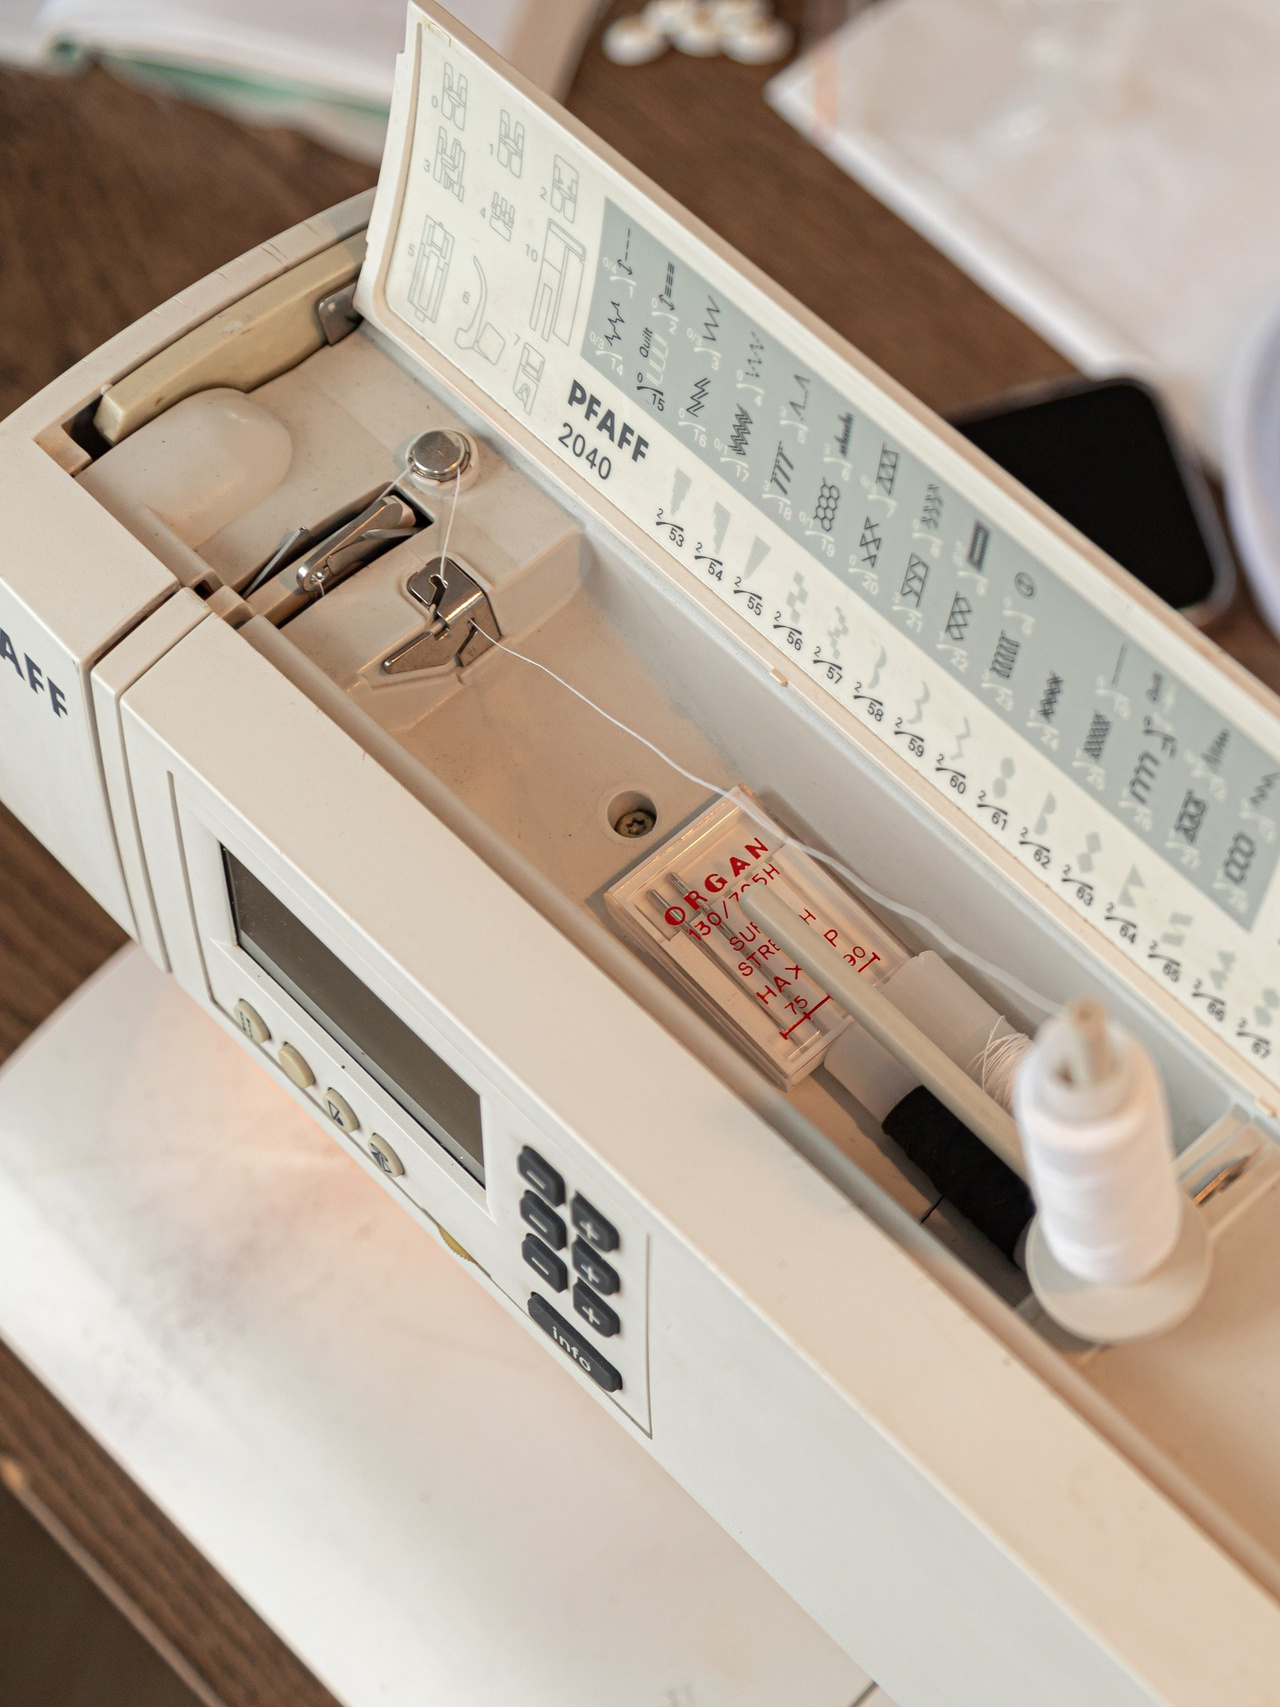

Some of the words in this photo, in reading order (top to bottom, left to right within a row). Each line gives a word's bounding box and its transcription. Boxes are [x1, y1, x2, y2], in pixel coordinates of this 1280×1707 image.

[431, 95, 438, 109] 0
[423, 159, 431, 173] 3
[540, 187, 548, 201] 2
[480, 207, 487, 219] 4
[408, 243, 416, 257] 5
[525, 243, 538, 263] 10
[462, 291, 471, 305] 6
[513, 333, 520, 346] 7
[639, 327, 653, 358] Quilt
[669, 321, 677, 335] 2
[590, 331, 605, 350] 0/3
[610, 357, 624, 377] 14
[711, 356, 720, 371] 3
[637, 372, 643, 383] 0
[652, 393, 665, 412] 15
[755, 394, 763, 408] 4
[567, 379, 650, 464] PFAFF
[679, 408, 685, 419] 0
[693, 428, 707, 448] 16
[558, 422, 612, 480] 2040
[735, 464, 750, 482] 17
[656, 508, 664, 519] 2
[669, 527, 685, 547] 53
[778, 501, 792, 520] 18
[695, 542, 703, 553] 2
[707, 562, 723, 581] 54
[821, 538, 836, 557] 19
[734, 576, 742, 588] 2
[747, 597, 763, 616] 55
[862, 575, 878, 595] 20
[774, 611, 782, 622] 2
[786, 631, 803, 651] 56
[813, 646, 822, 658] 2
[826, 666, 843, 684] 57
[854, 681, 862, 693] 2
[867, 702, 884, 722] 58
[895, 717, 903, 728] 2
[908, 738, 925, 758] 59
[936, 753, 944, 765] 2
[949, 775, 966, 795] 60
[978, 790, 986, 801] 2
[991, 811, 1008, 831] 61
[1020, 827, 1028, 839] 2
[1033, 849, 1051, 870] 62
[664, 837, 769, 926] ORGAN
[1062, 864, 1071, 876] 2
[1076, 886, 1094, 907] 63
[1106, 902, 1115, 914] 2
[1119, 924, 1137, 945] 64
[1162, 962, 1181, 983] 65
[784, 995, 808, 1015] 75
[1251, 1040, 1271, 1060] 67
[552, 1326, 592, 1373] info
